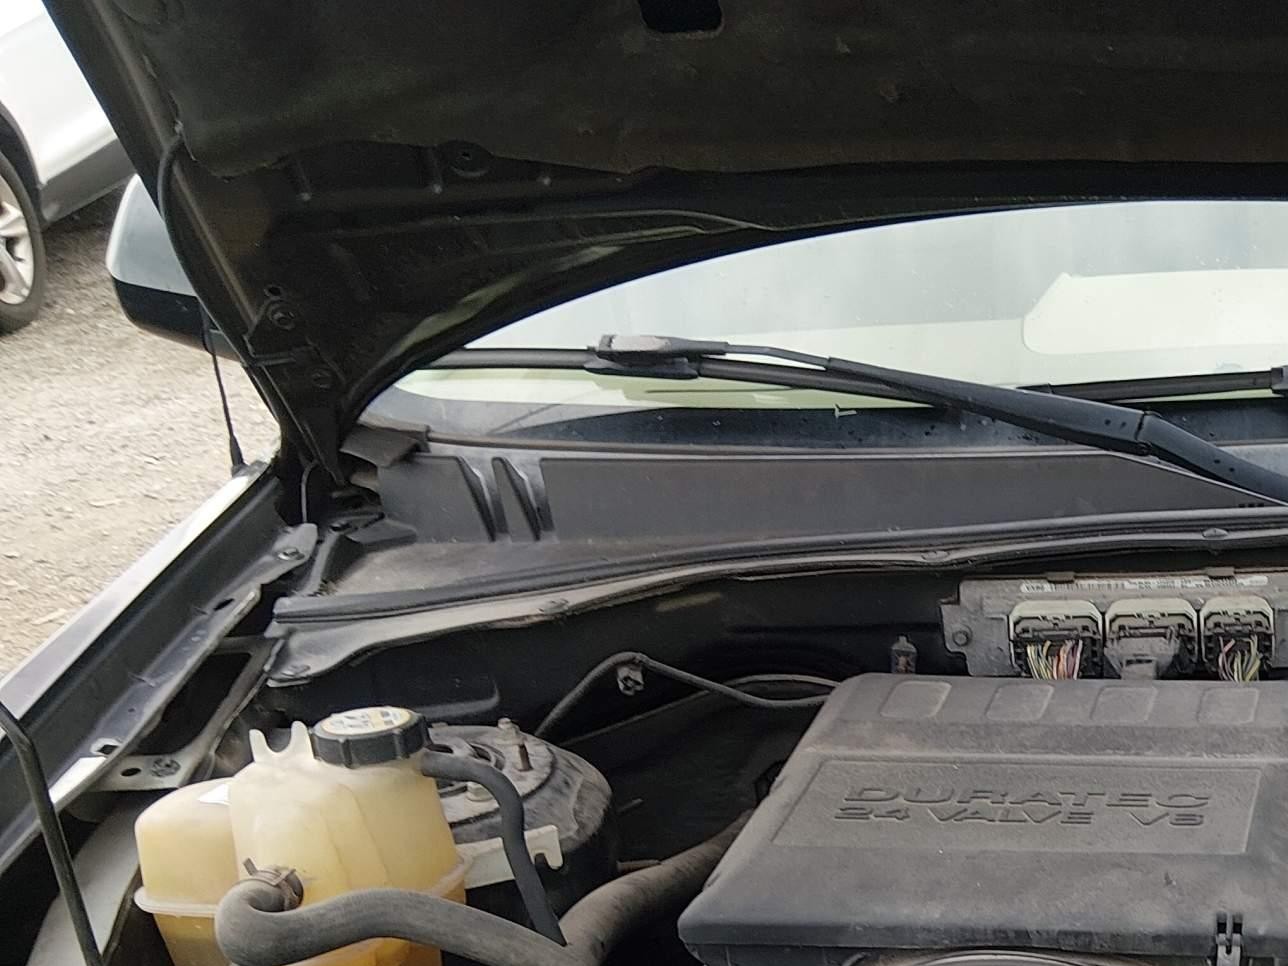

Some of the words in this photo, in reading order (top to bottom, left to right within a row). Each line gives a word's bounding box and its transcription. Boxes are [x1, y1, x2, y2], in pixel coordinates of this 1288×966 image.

[844, 787, 1209, 809] DURATEC
[834, 807, 910, 821] 24
[928, 808, 1095, 825] VALVE
[1129, 811, 1205, 827] V6
